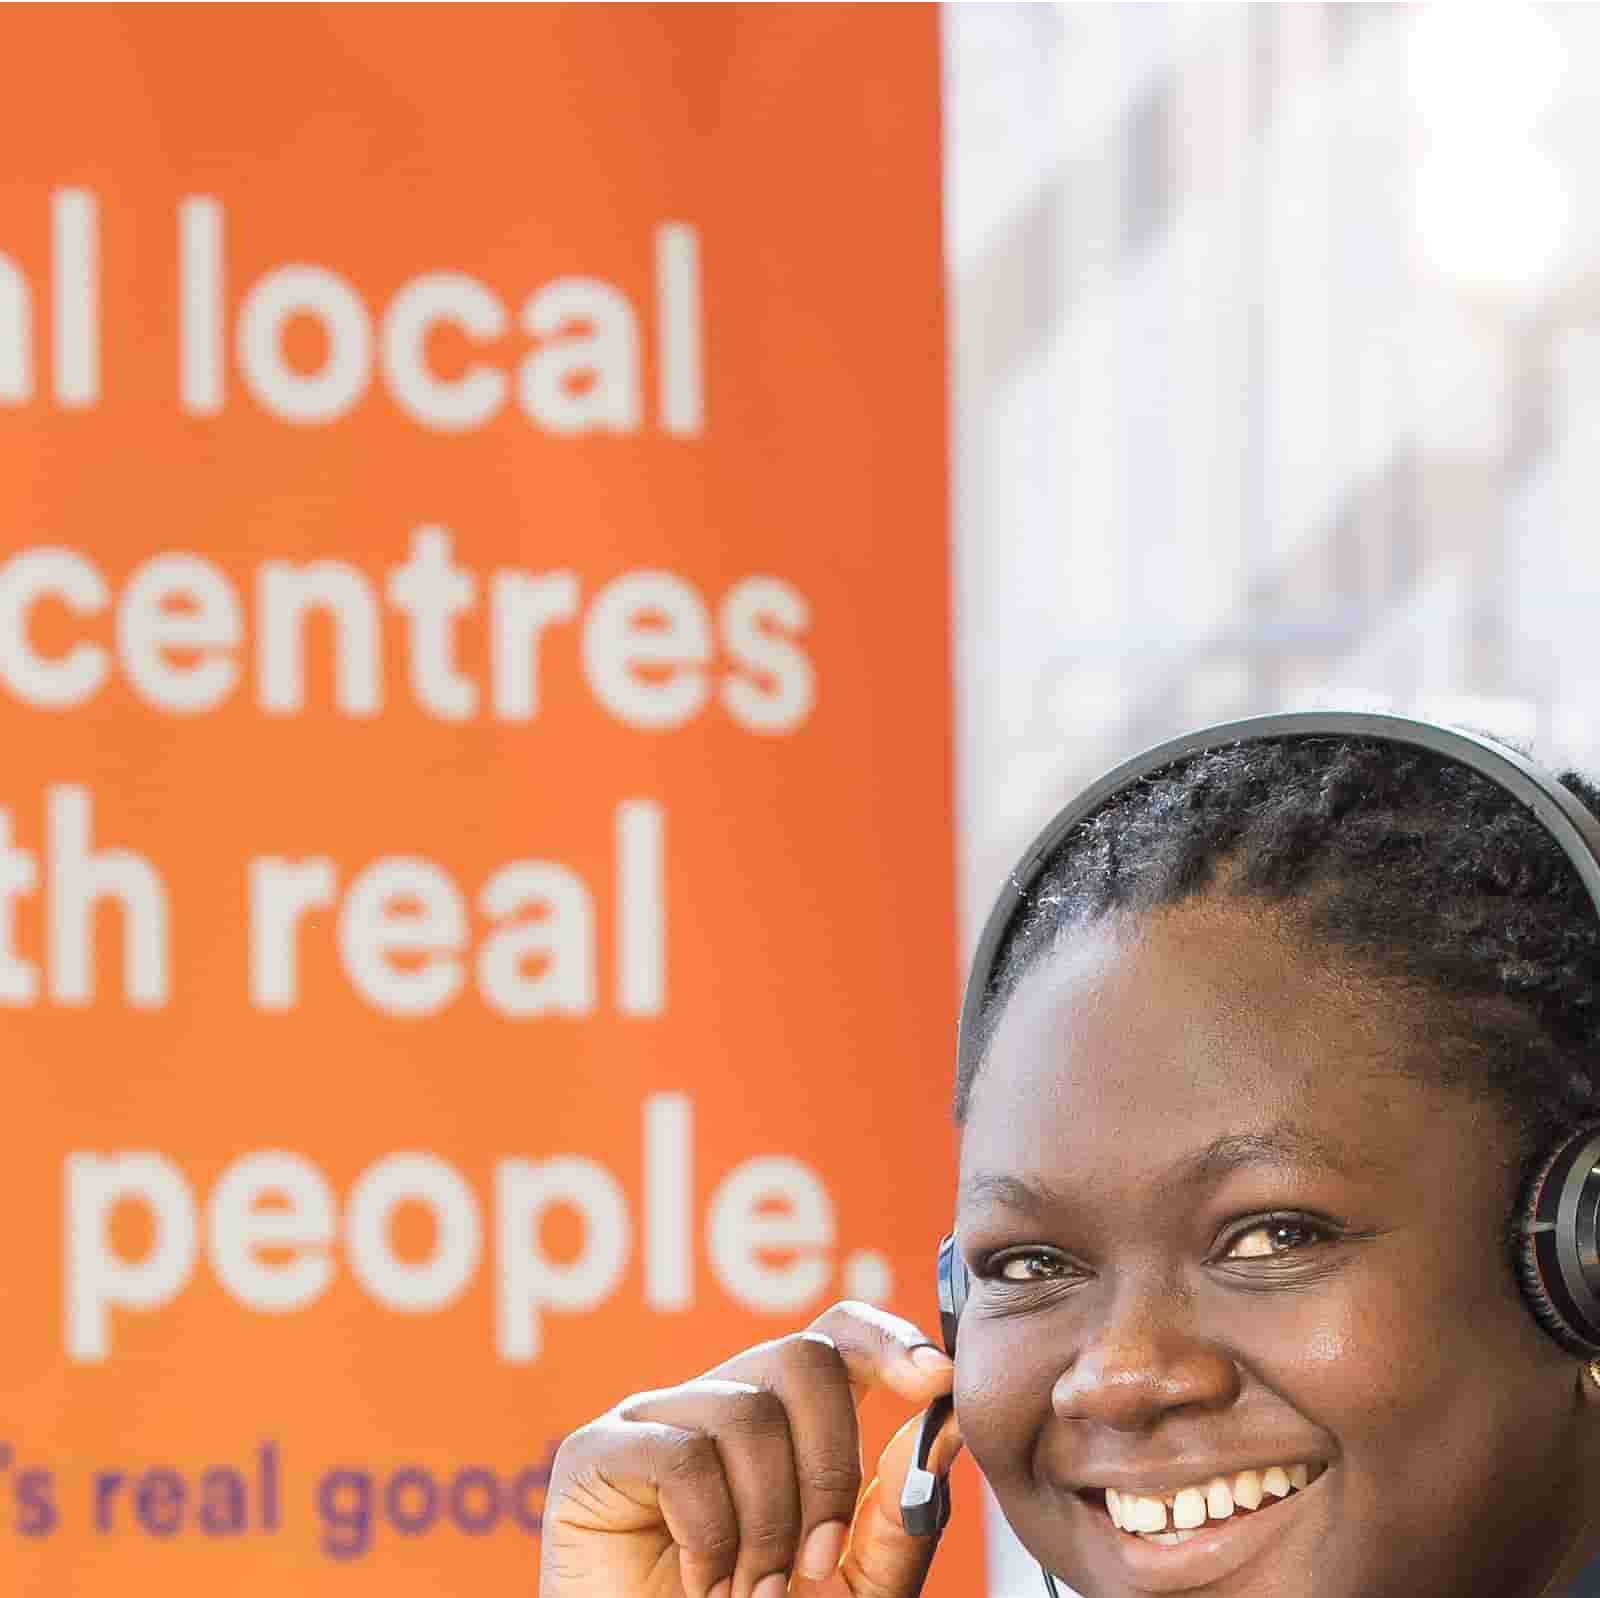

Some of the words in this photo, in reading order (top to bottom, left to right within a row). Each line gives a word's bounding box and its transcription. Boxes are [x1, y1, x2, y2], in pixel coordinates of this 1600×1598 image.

[180, 197, 704, 434] local
[250, 800, 665, 1017] real
[64, 1092, 891, 1363] people.
[96, 1440, 277, 1538] real
